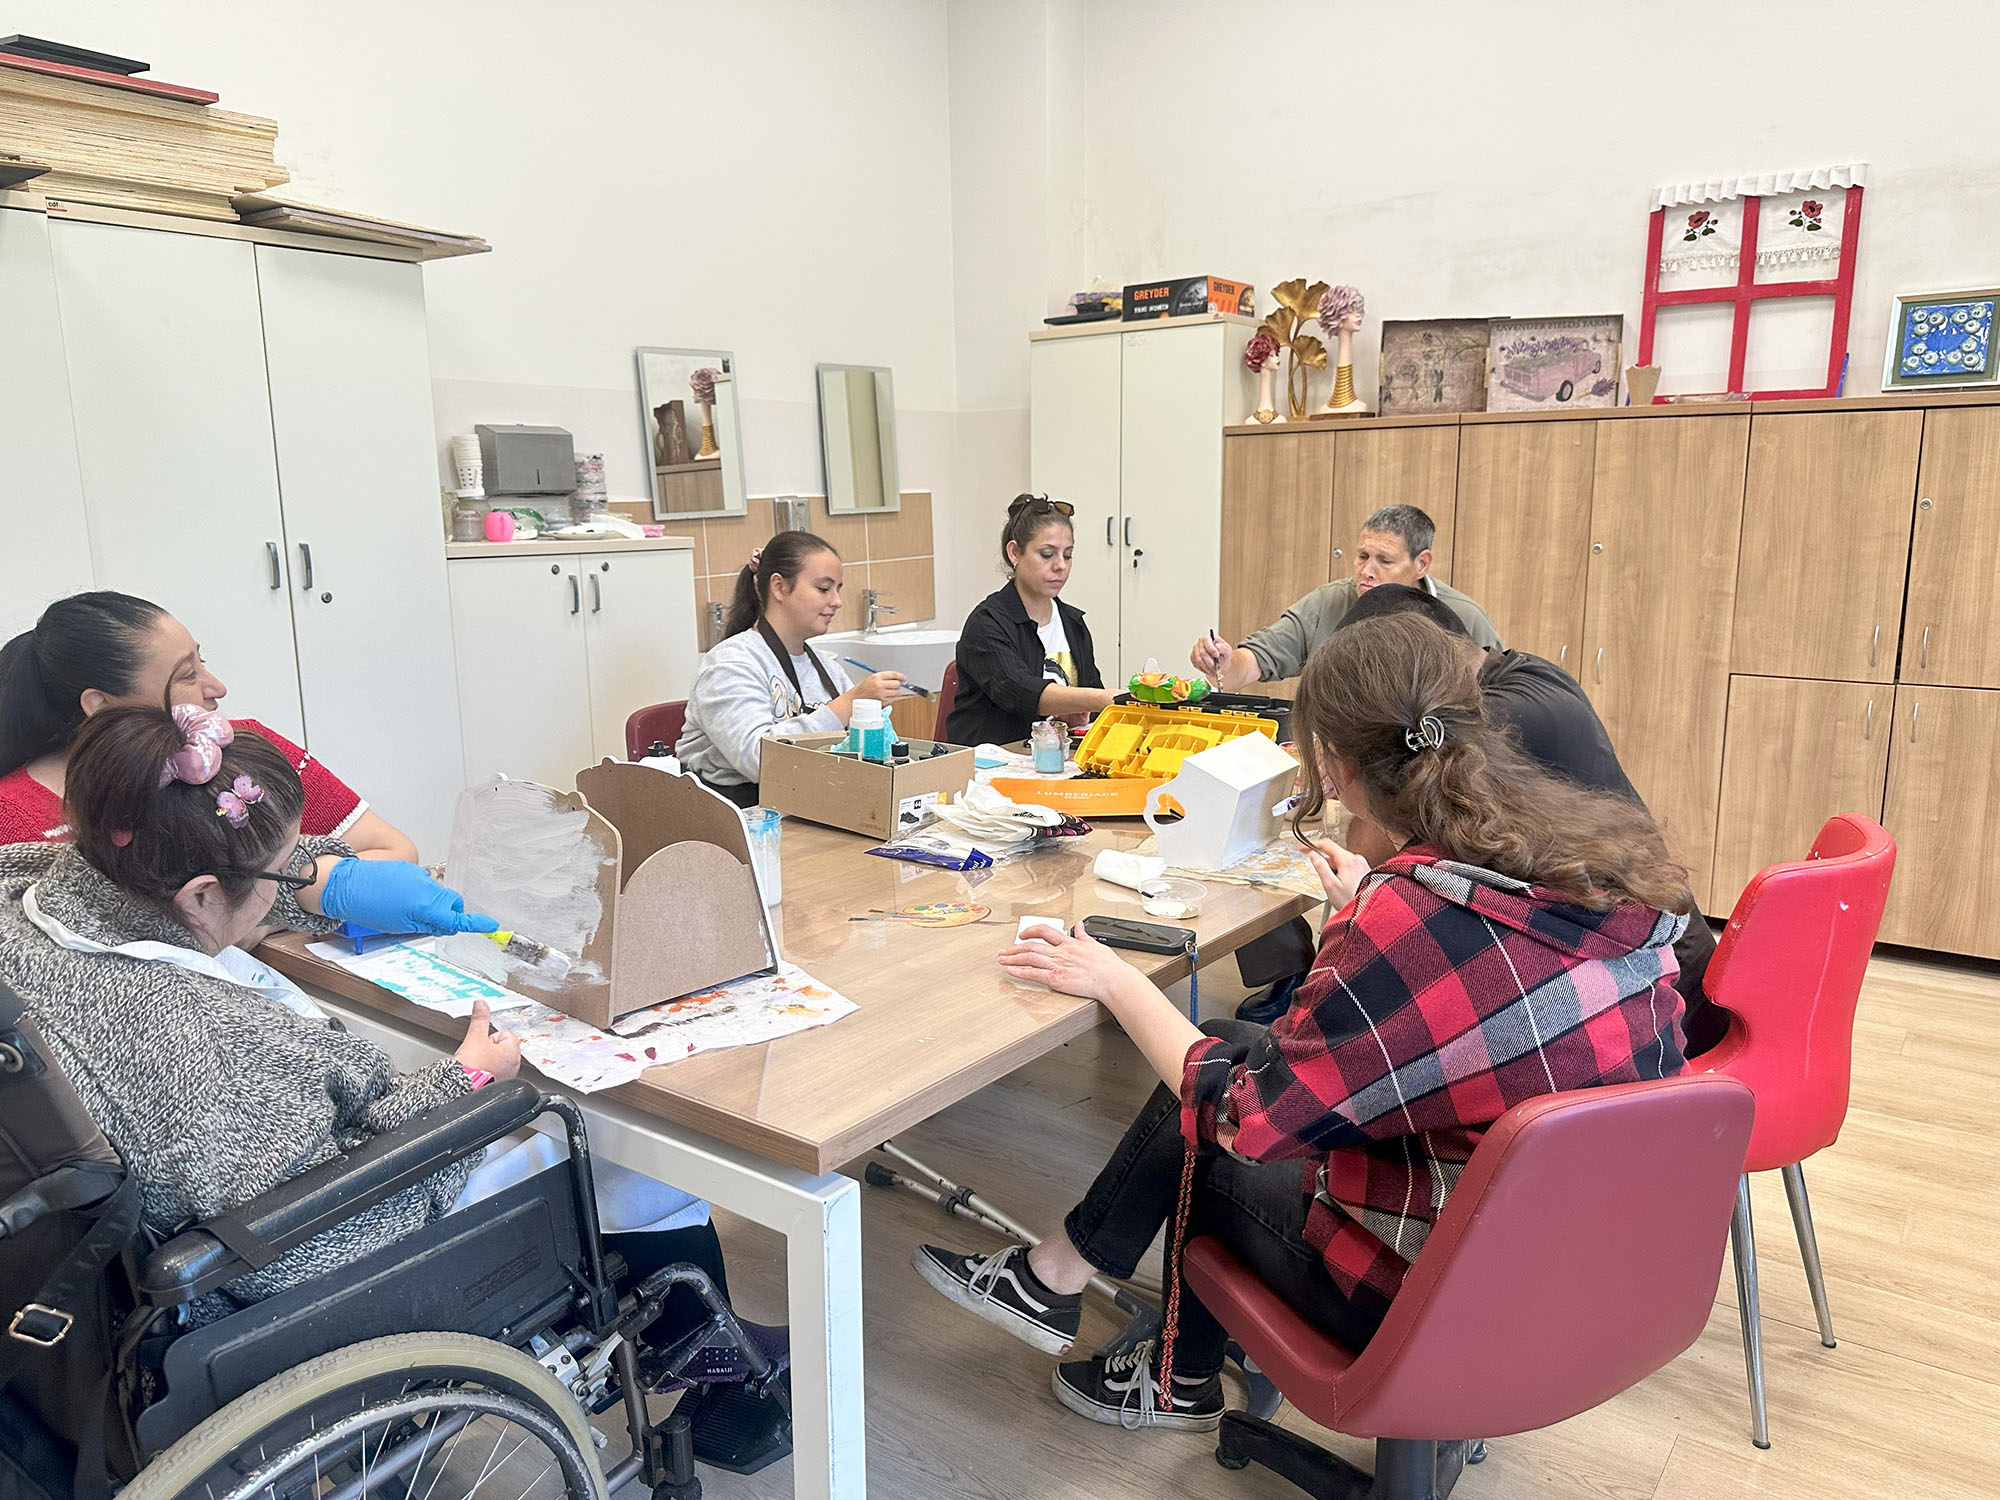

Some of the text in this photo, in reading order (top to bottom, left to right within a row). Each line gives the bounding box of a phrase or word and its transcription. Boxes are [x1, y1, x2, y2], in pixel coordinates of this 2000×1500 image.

[1133, 287, 1169, 301] GREYDER
[1213, 281, 1235, 295] GREYDER
[1496, 319, 1609, 332] LAVENDER FIELDS FARM
